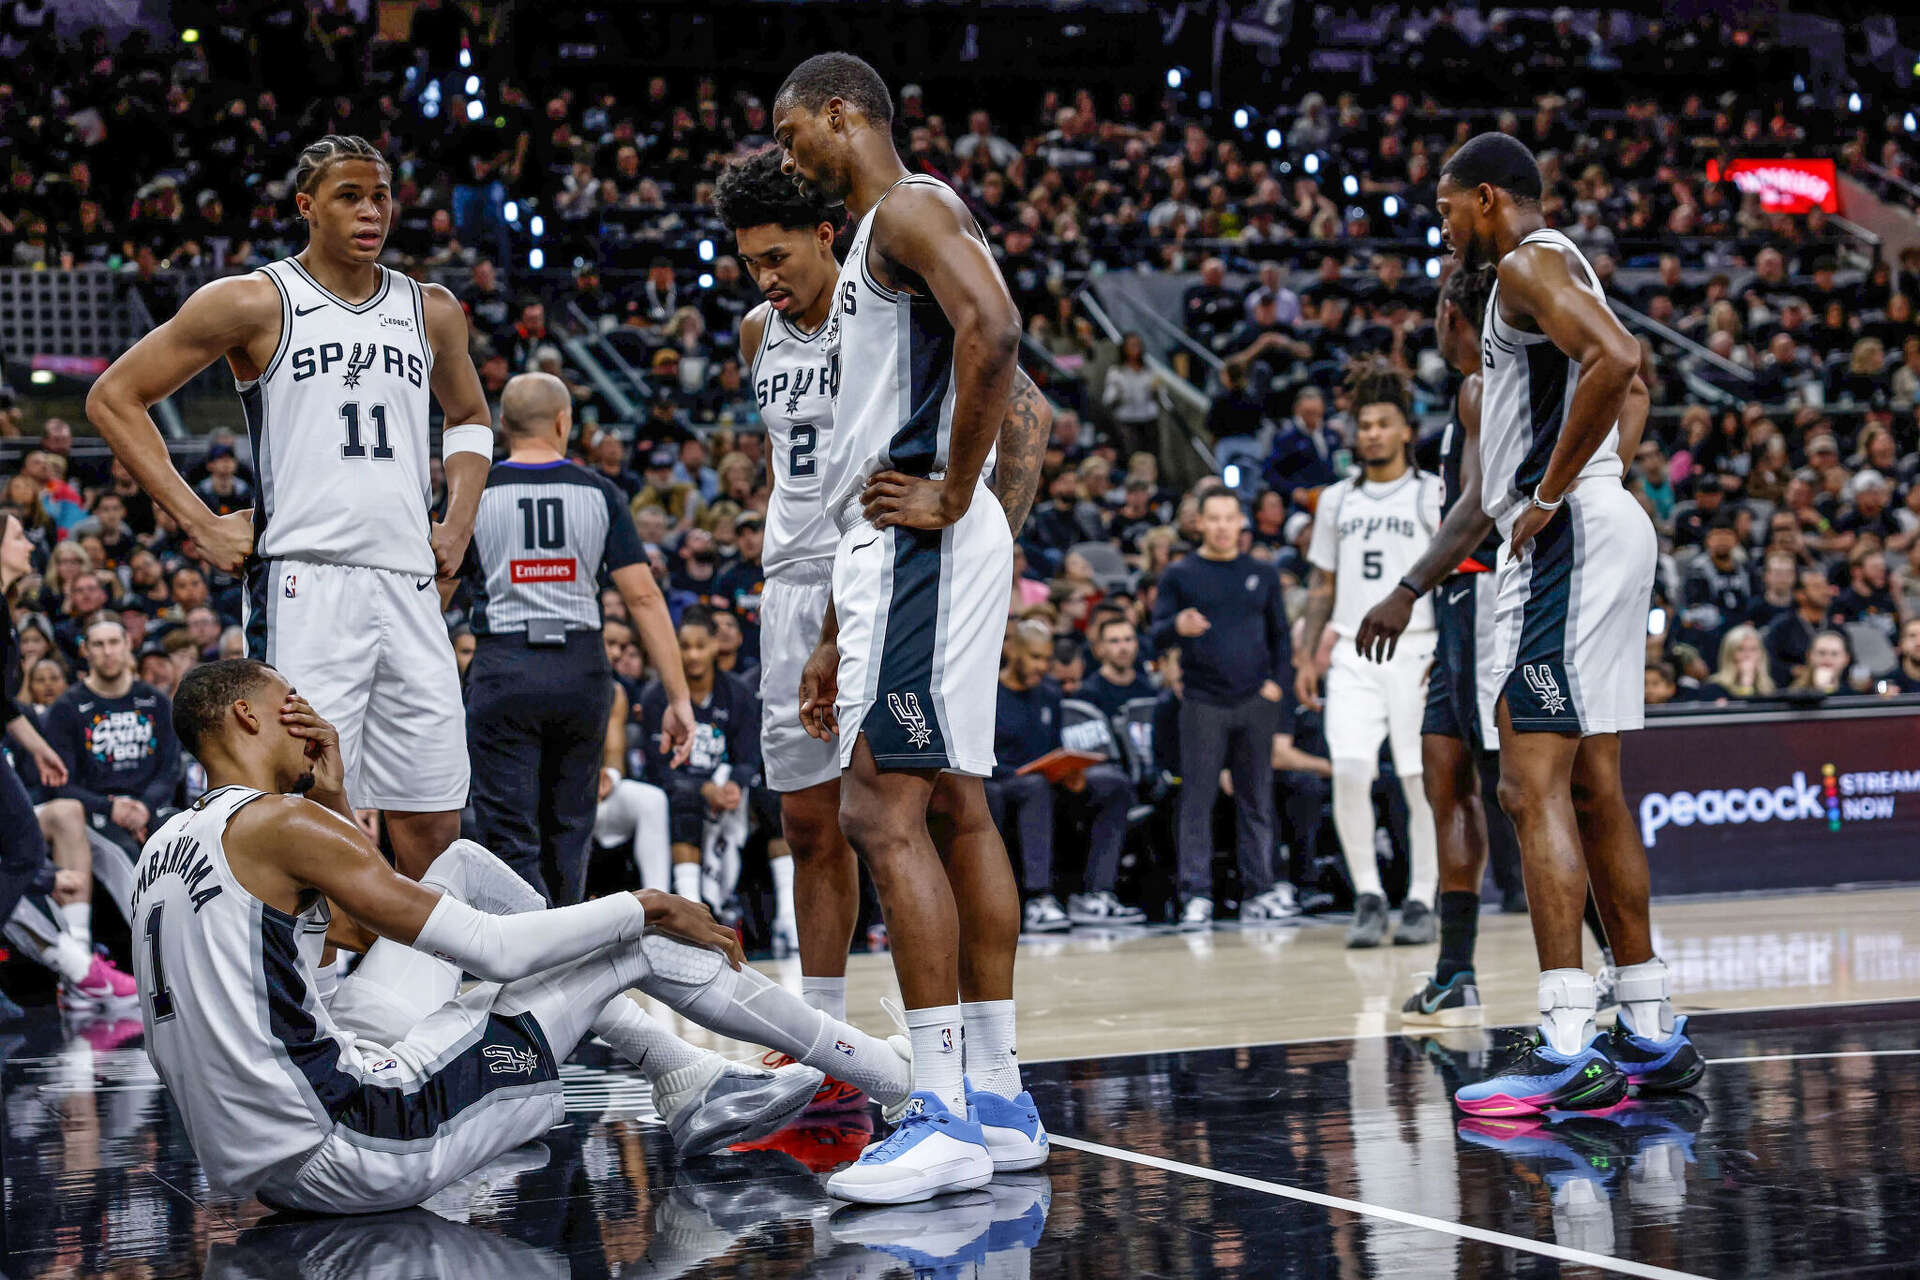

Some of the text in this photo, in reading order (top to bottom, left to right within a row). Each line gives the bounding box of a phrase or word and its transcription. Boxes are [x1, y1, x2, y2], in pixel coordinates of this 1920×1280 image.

[383, 316, 409, 327] LEDGER
[292, 342, 423, 390] SPURS
[339, 401, 395, 462] 11
[788, 423, 819, 480] 2
[518, 498, 565, 550] 10
[1337, 515, 1415, 541] SPURS
[515, 564, 570, 578] Emirates
[1362, 550, 1383, 580] 5
[1639, 771, 1826, 848] peacock
[1841, 796, 1895, 821] NOW
[130, 835, 223, 929] EMBANYAMA
[144, 900, 177, 1025] 1
